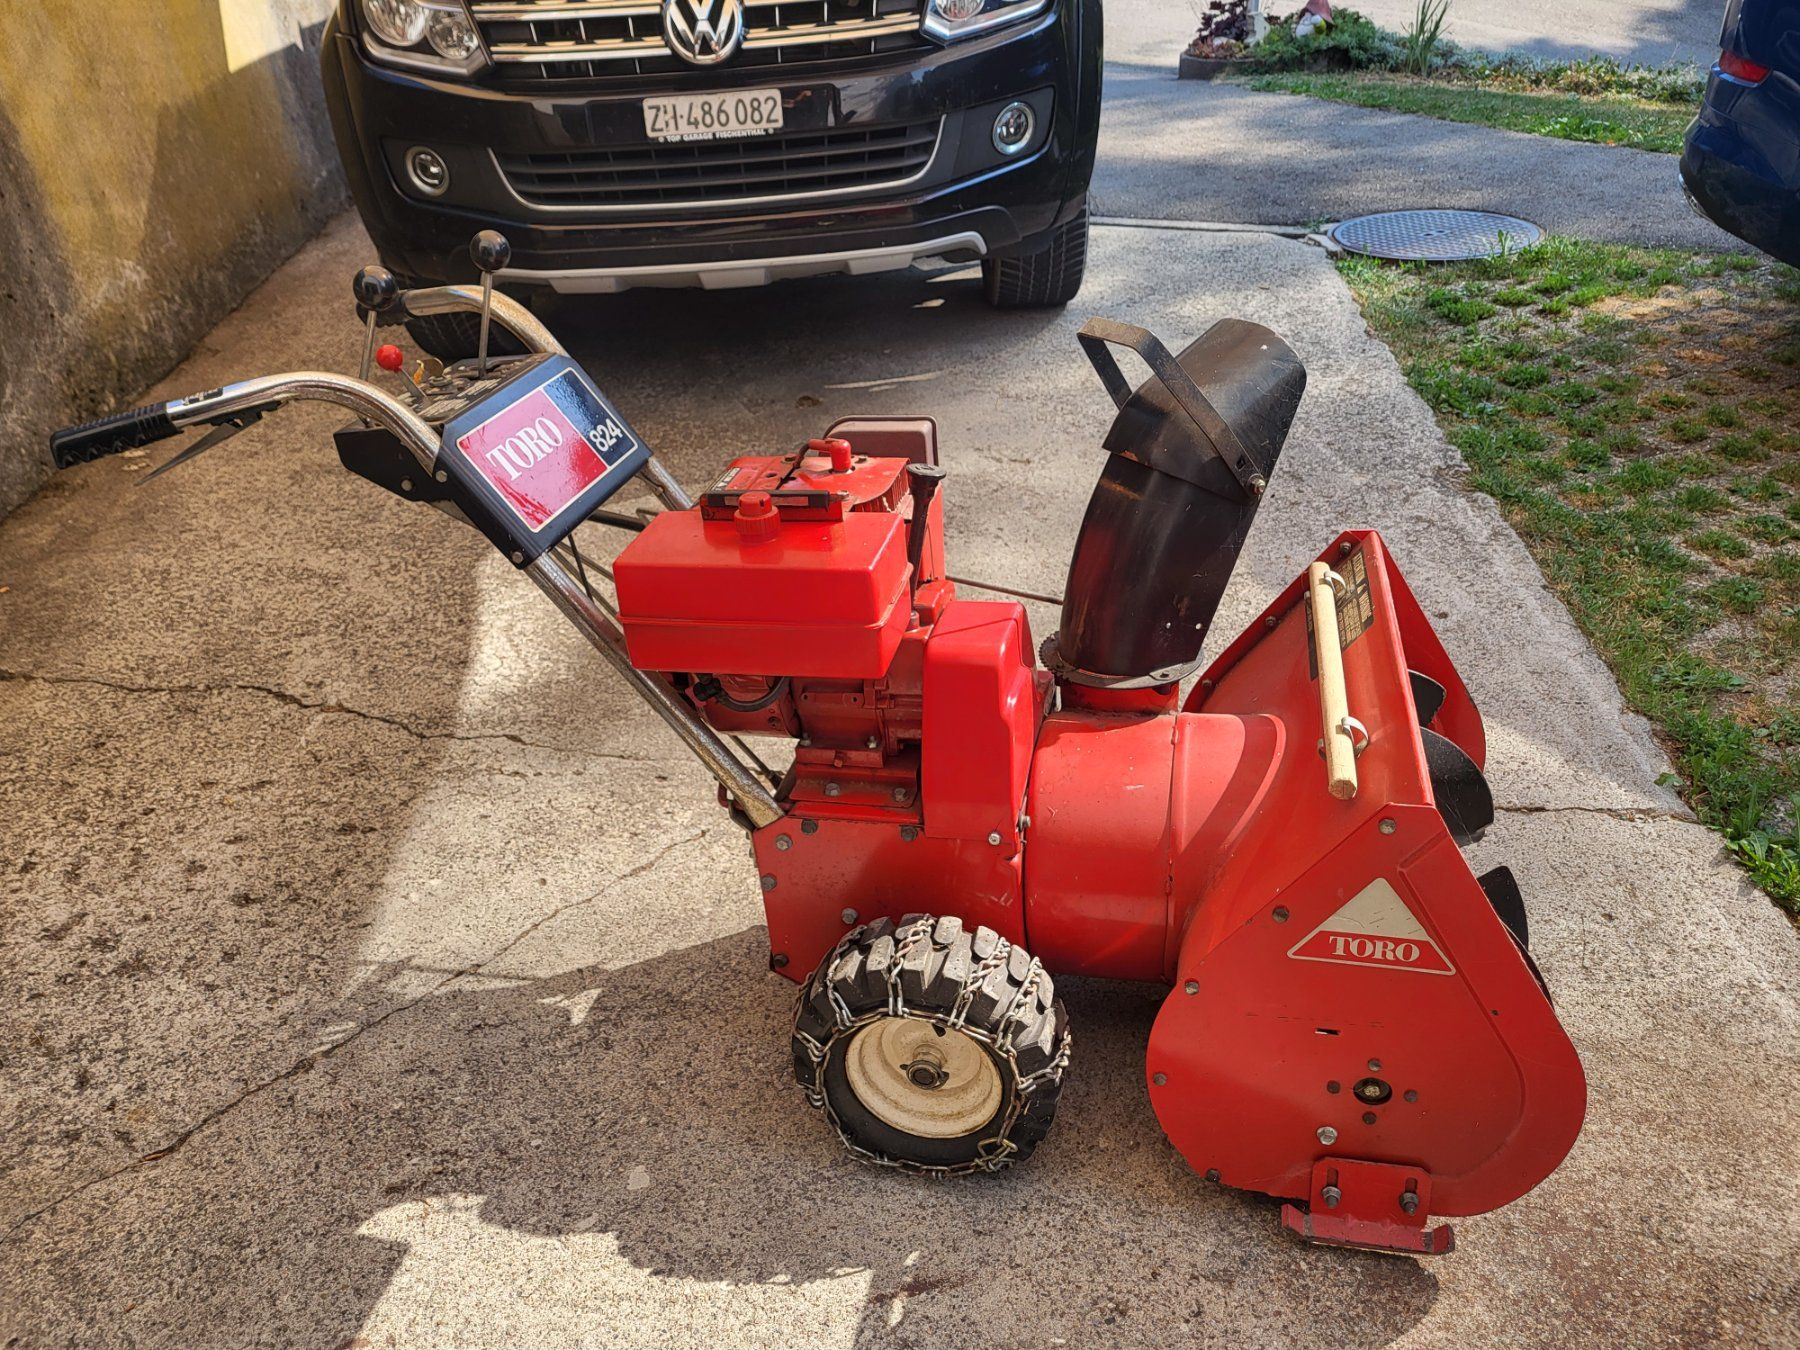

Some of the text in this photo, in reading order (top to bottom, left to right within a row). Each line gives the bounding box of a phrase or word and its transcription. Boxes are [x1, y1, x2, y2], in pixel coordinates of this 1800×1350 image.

[683, 132, 714, 141] GARAGE
[485, 417, 563, 481] TORO
[589, 418, 624, 452] 824
[1329, 935, 1420, 962] TORO
